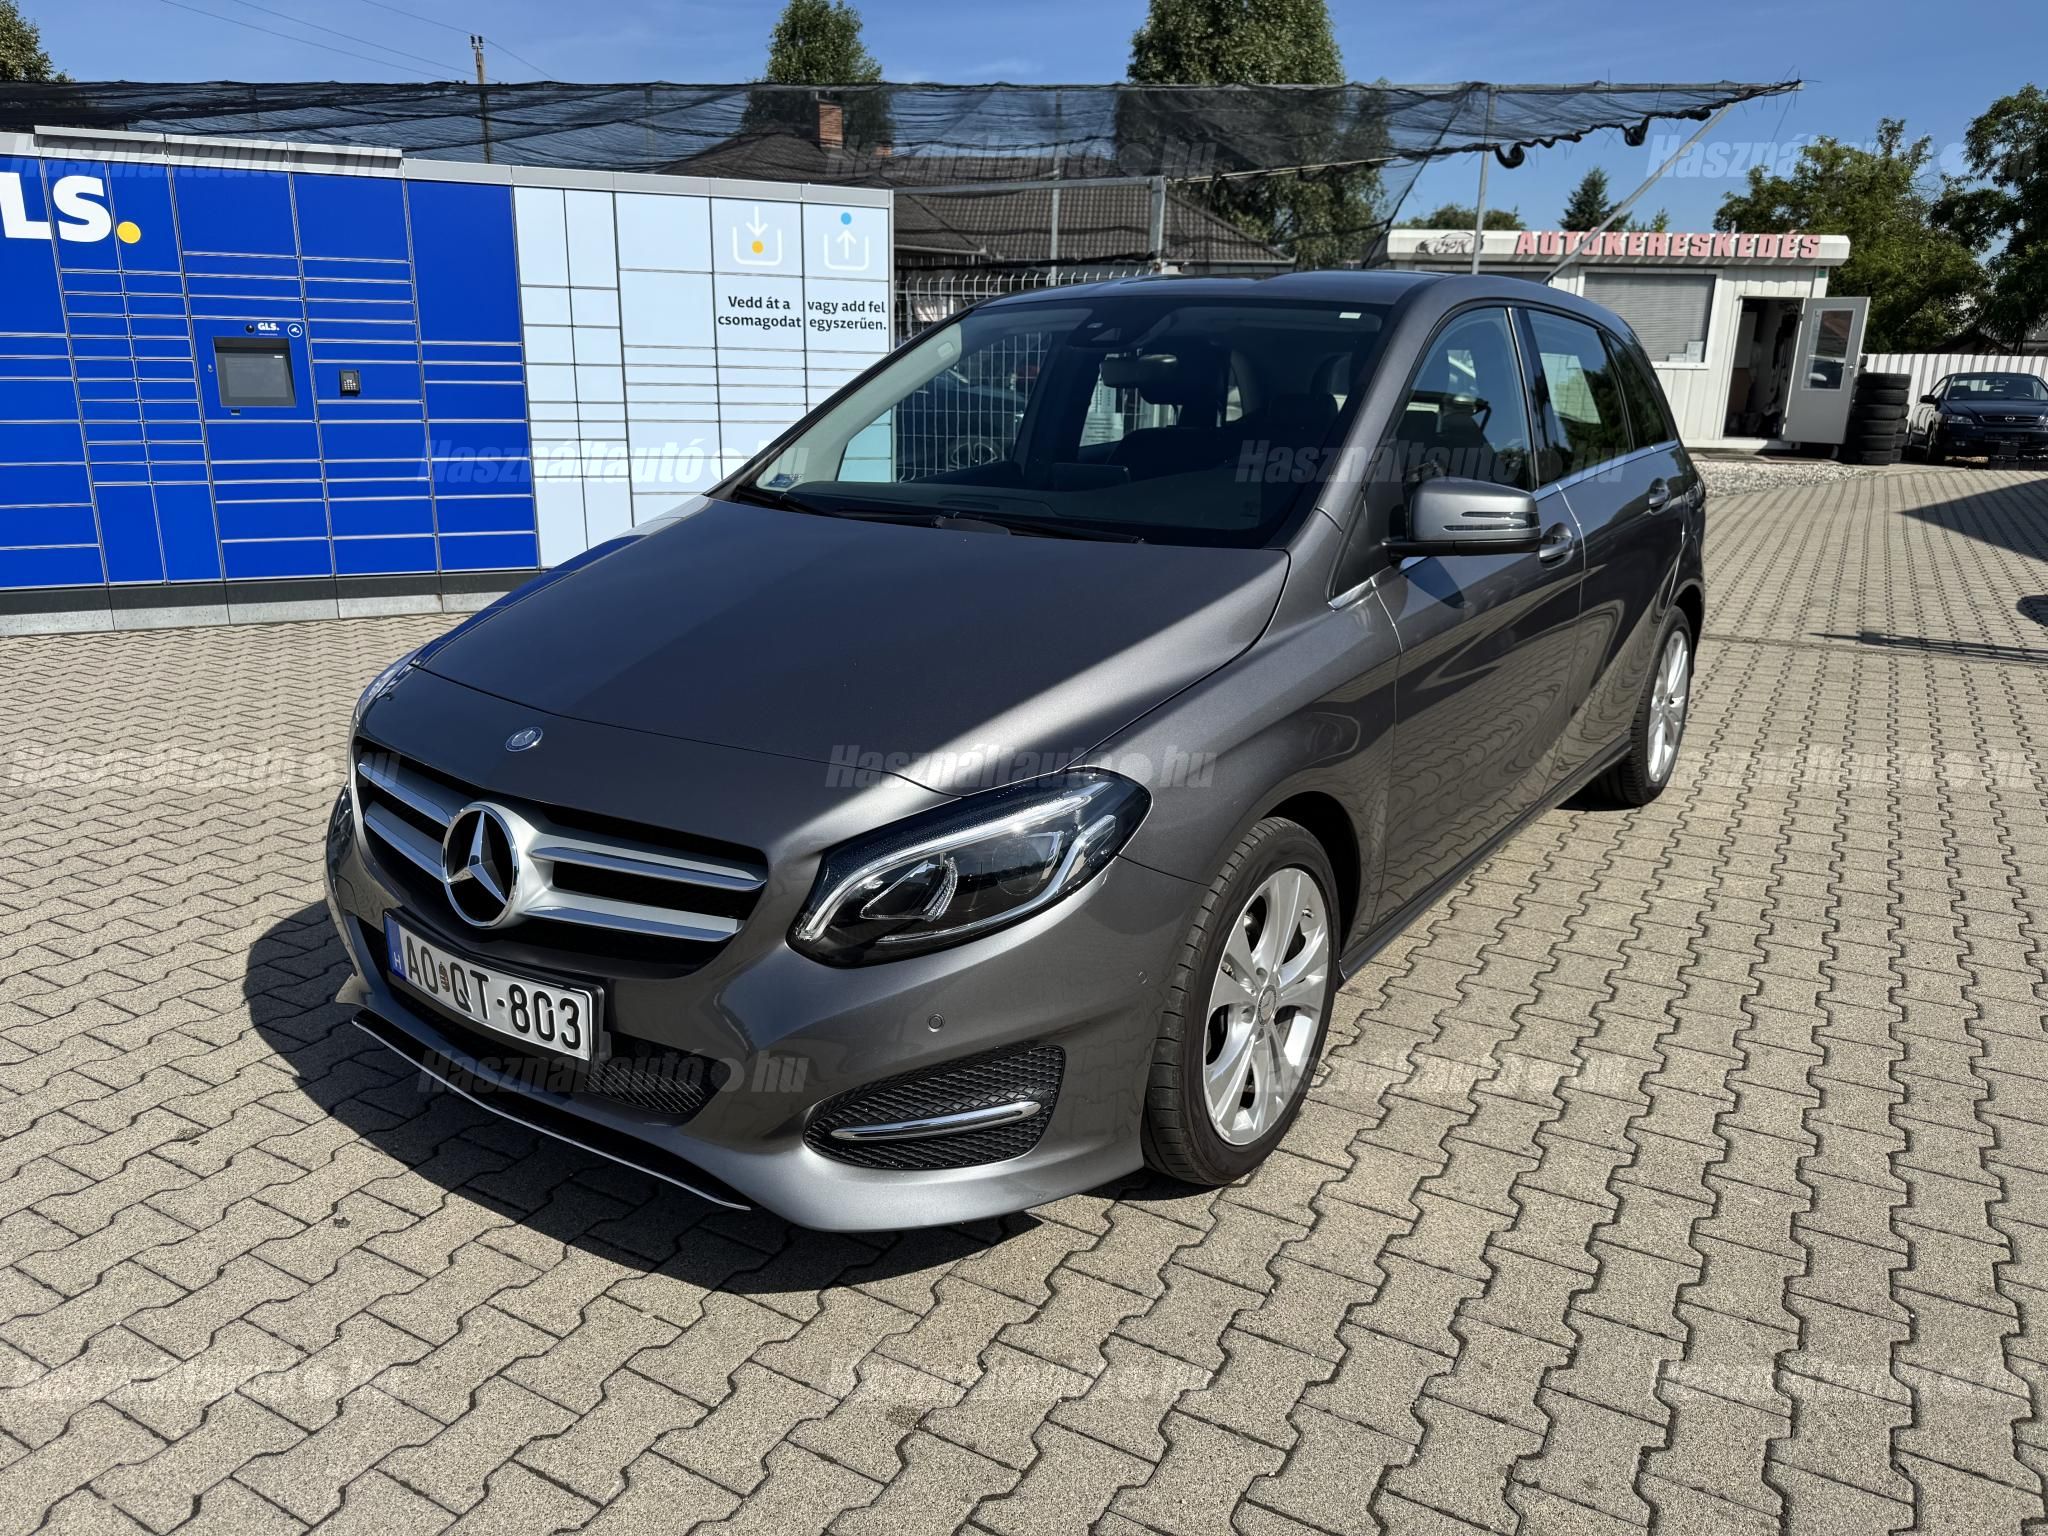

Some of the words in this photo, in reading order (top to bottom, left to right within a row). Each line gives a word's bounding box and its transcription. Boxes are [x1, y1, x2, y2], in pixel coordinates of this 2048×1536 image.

[1515, 226, 1821, 258] AUTÓKERESKEDÉS
[728, 295, 763, 309] Vedd
[766, 296, 780, 309] át
[783, 300, 791, 310] a
[807, 301, 839, 315] vagy
[841, 301, 866, 313] add
[868, 301, 886, 313] fel
[717, 314, 802, 331] csomagodat
[809, 317, 887, 332] egyszerűen.
[393, 952, 402, 970] H
